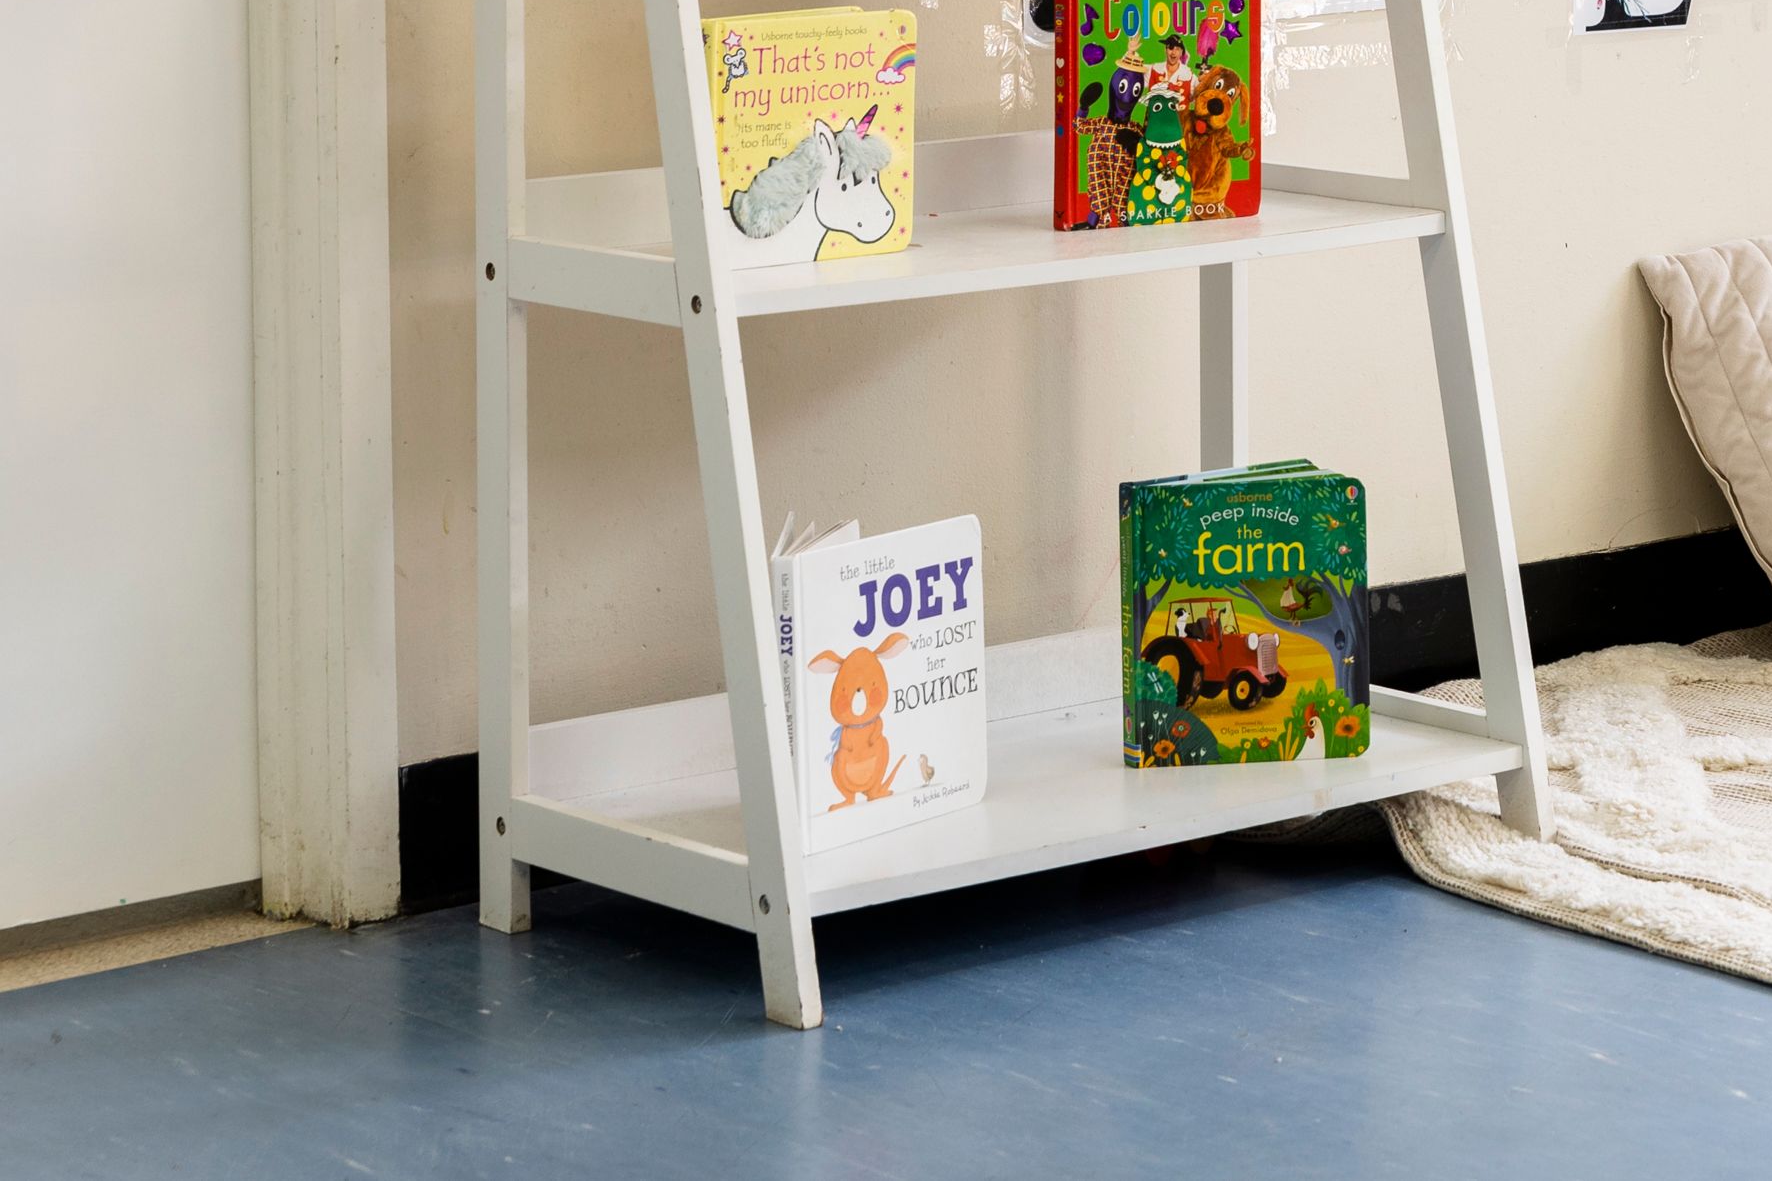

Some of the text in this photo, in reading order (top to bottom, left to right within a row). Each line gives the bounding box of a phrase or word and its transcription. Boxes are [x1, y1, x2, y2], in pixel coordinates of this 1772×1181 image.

[761, 26, 867, 42] Usborne touchy-feely books
[753, 43, 876, 75] That's not
[734, 79, 890, 117] my unicorn...
[755, 121, 792, 132] mane is
[741, 138, 758, 149] too
[1103, 203, 1226, 224] A SPARKLE BOOK
[1227, 491, 1273, 503] usborne
[1199, 503, 1300, 530] peep inside
[1236, 527, 1263, 540] the
[1192, 531, 1306, 576] farm
[840, 556, 896, 582] the little
[853, 557, 974, 638] JOEY
[780, 614, 793, 657] JOEY
[910, 620, 977, 652] who LOST
[926, 655, 946, 673] her
[1121, 645, 1131, 695] farm
[893, 667, 979, 714] BOUNCE
